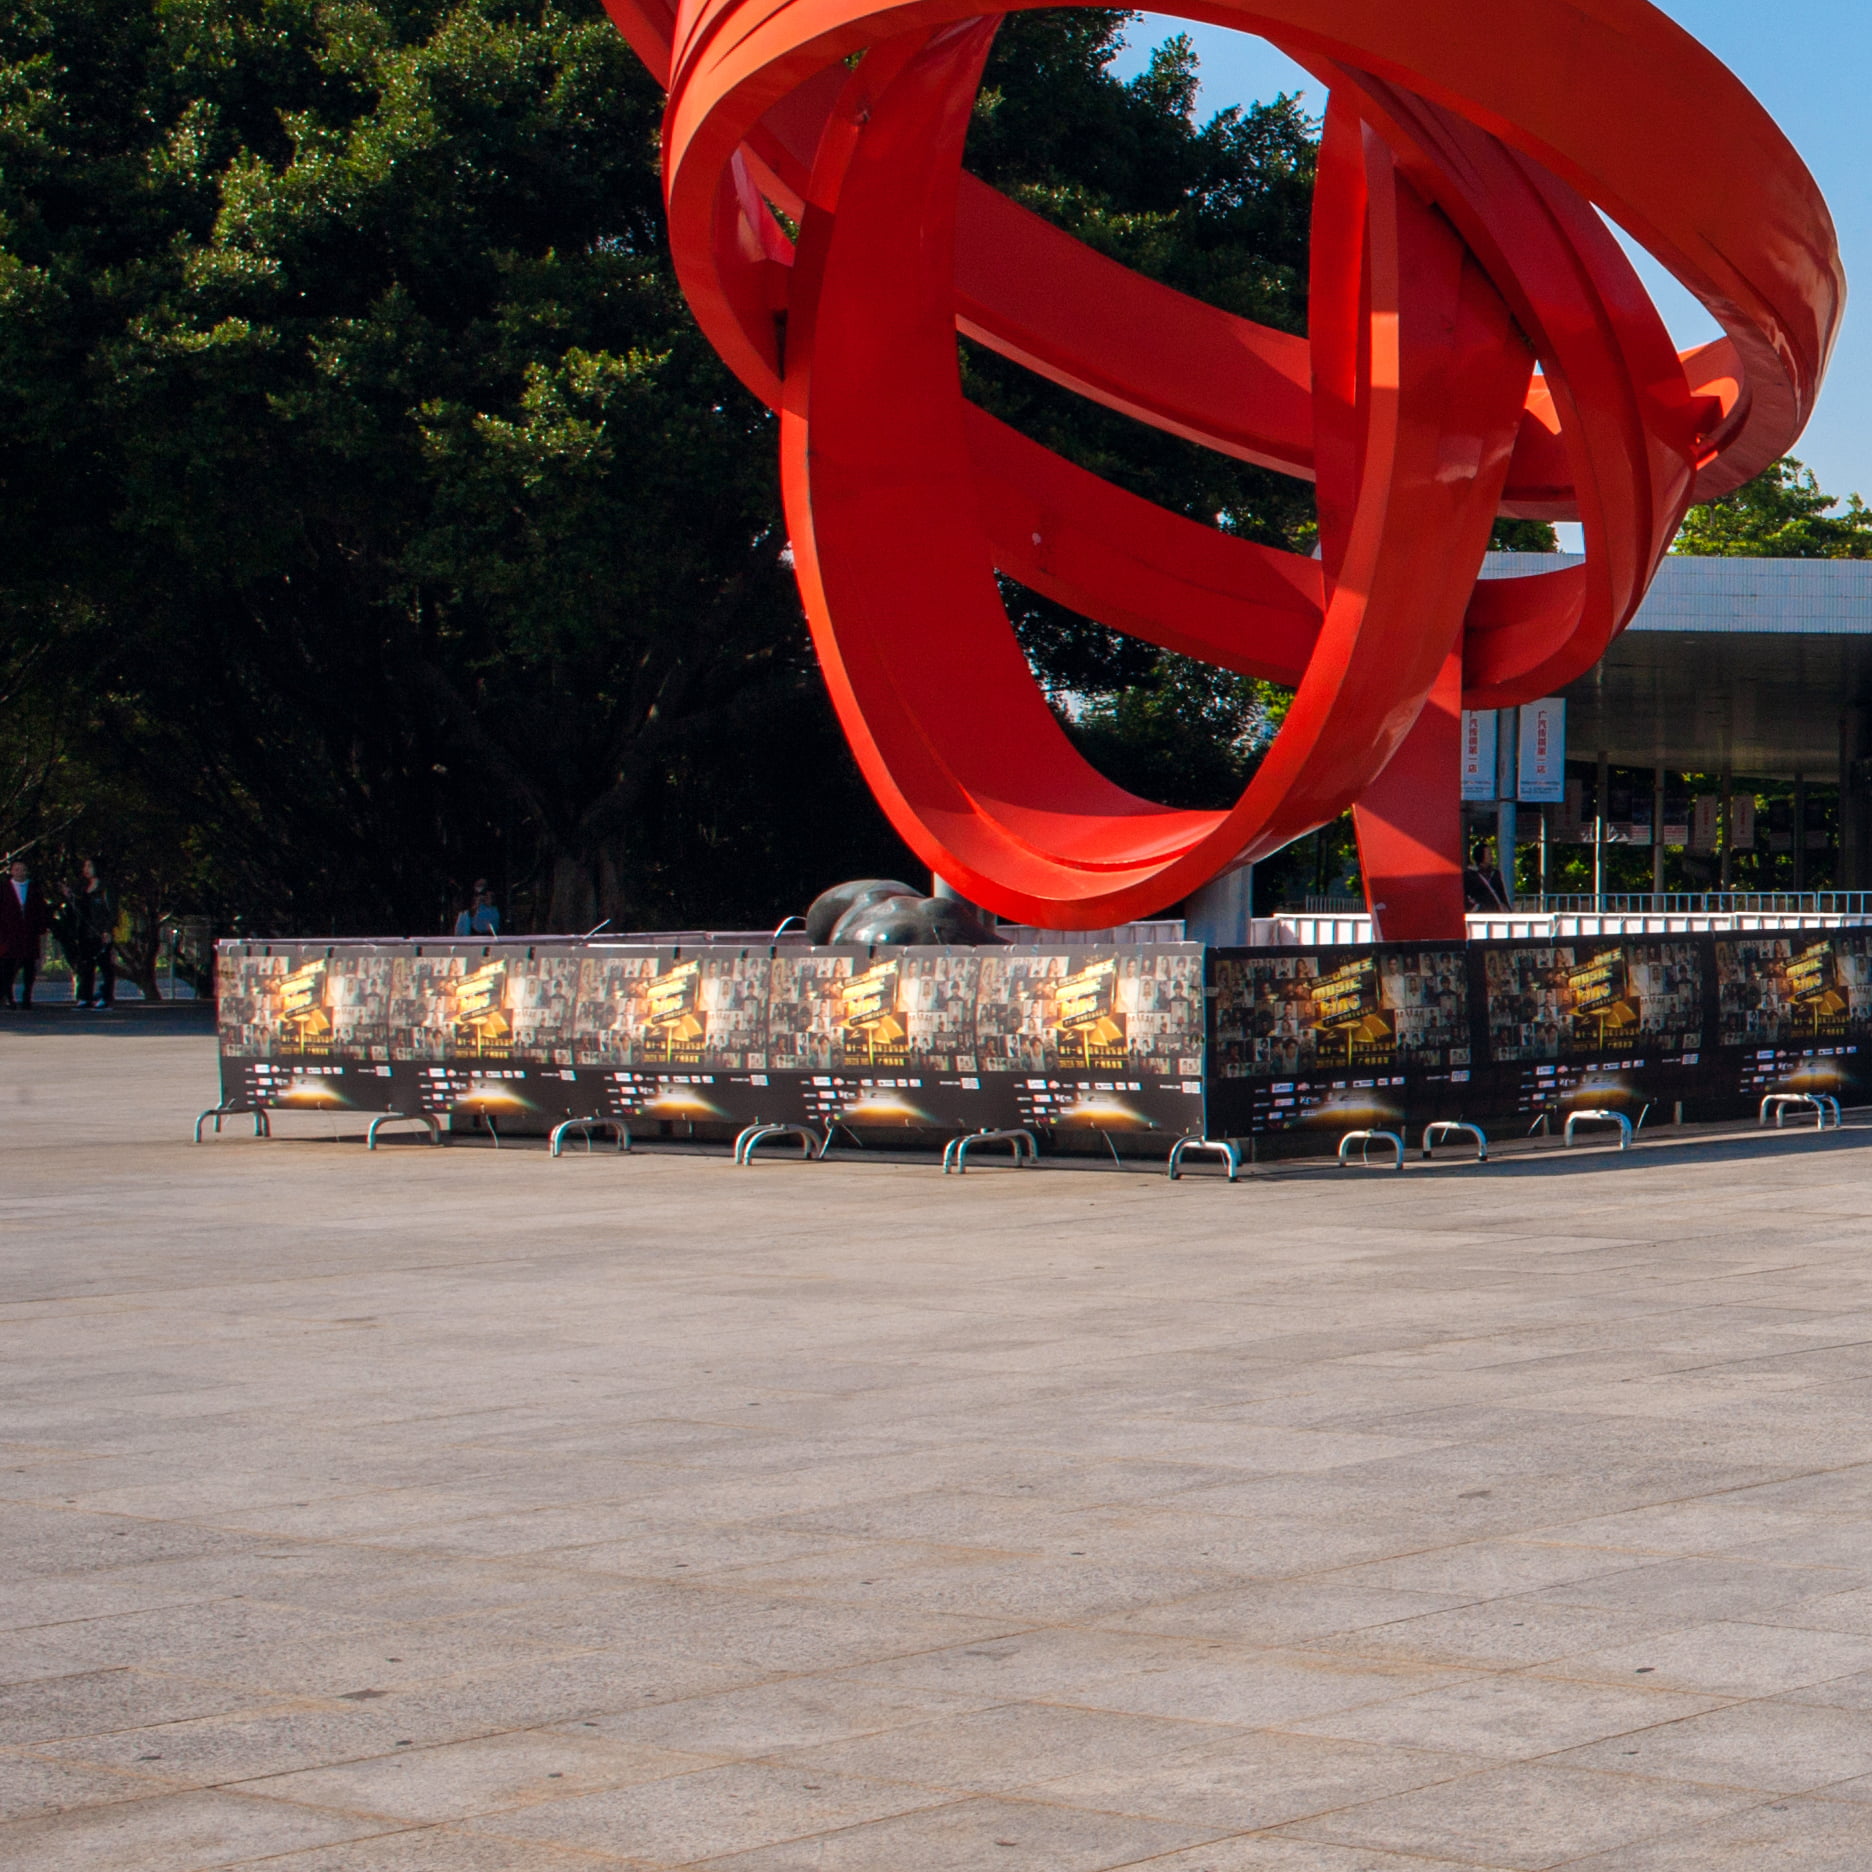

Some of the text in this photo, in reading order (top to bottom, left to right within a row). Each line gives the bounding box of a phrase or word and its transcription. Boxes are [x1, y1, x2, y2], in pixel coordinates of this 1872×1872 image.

[1537, 710, 1547, 774] 广汽传祺第一店
[1311, 976, 1363, 1000] MUSIC
[1569, 964, 1613, 989] MUSIC
